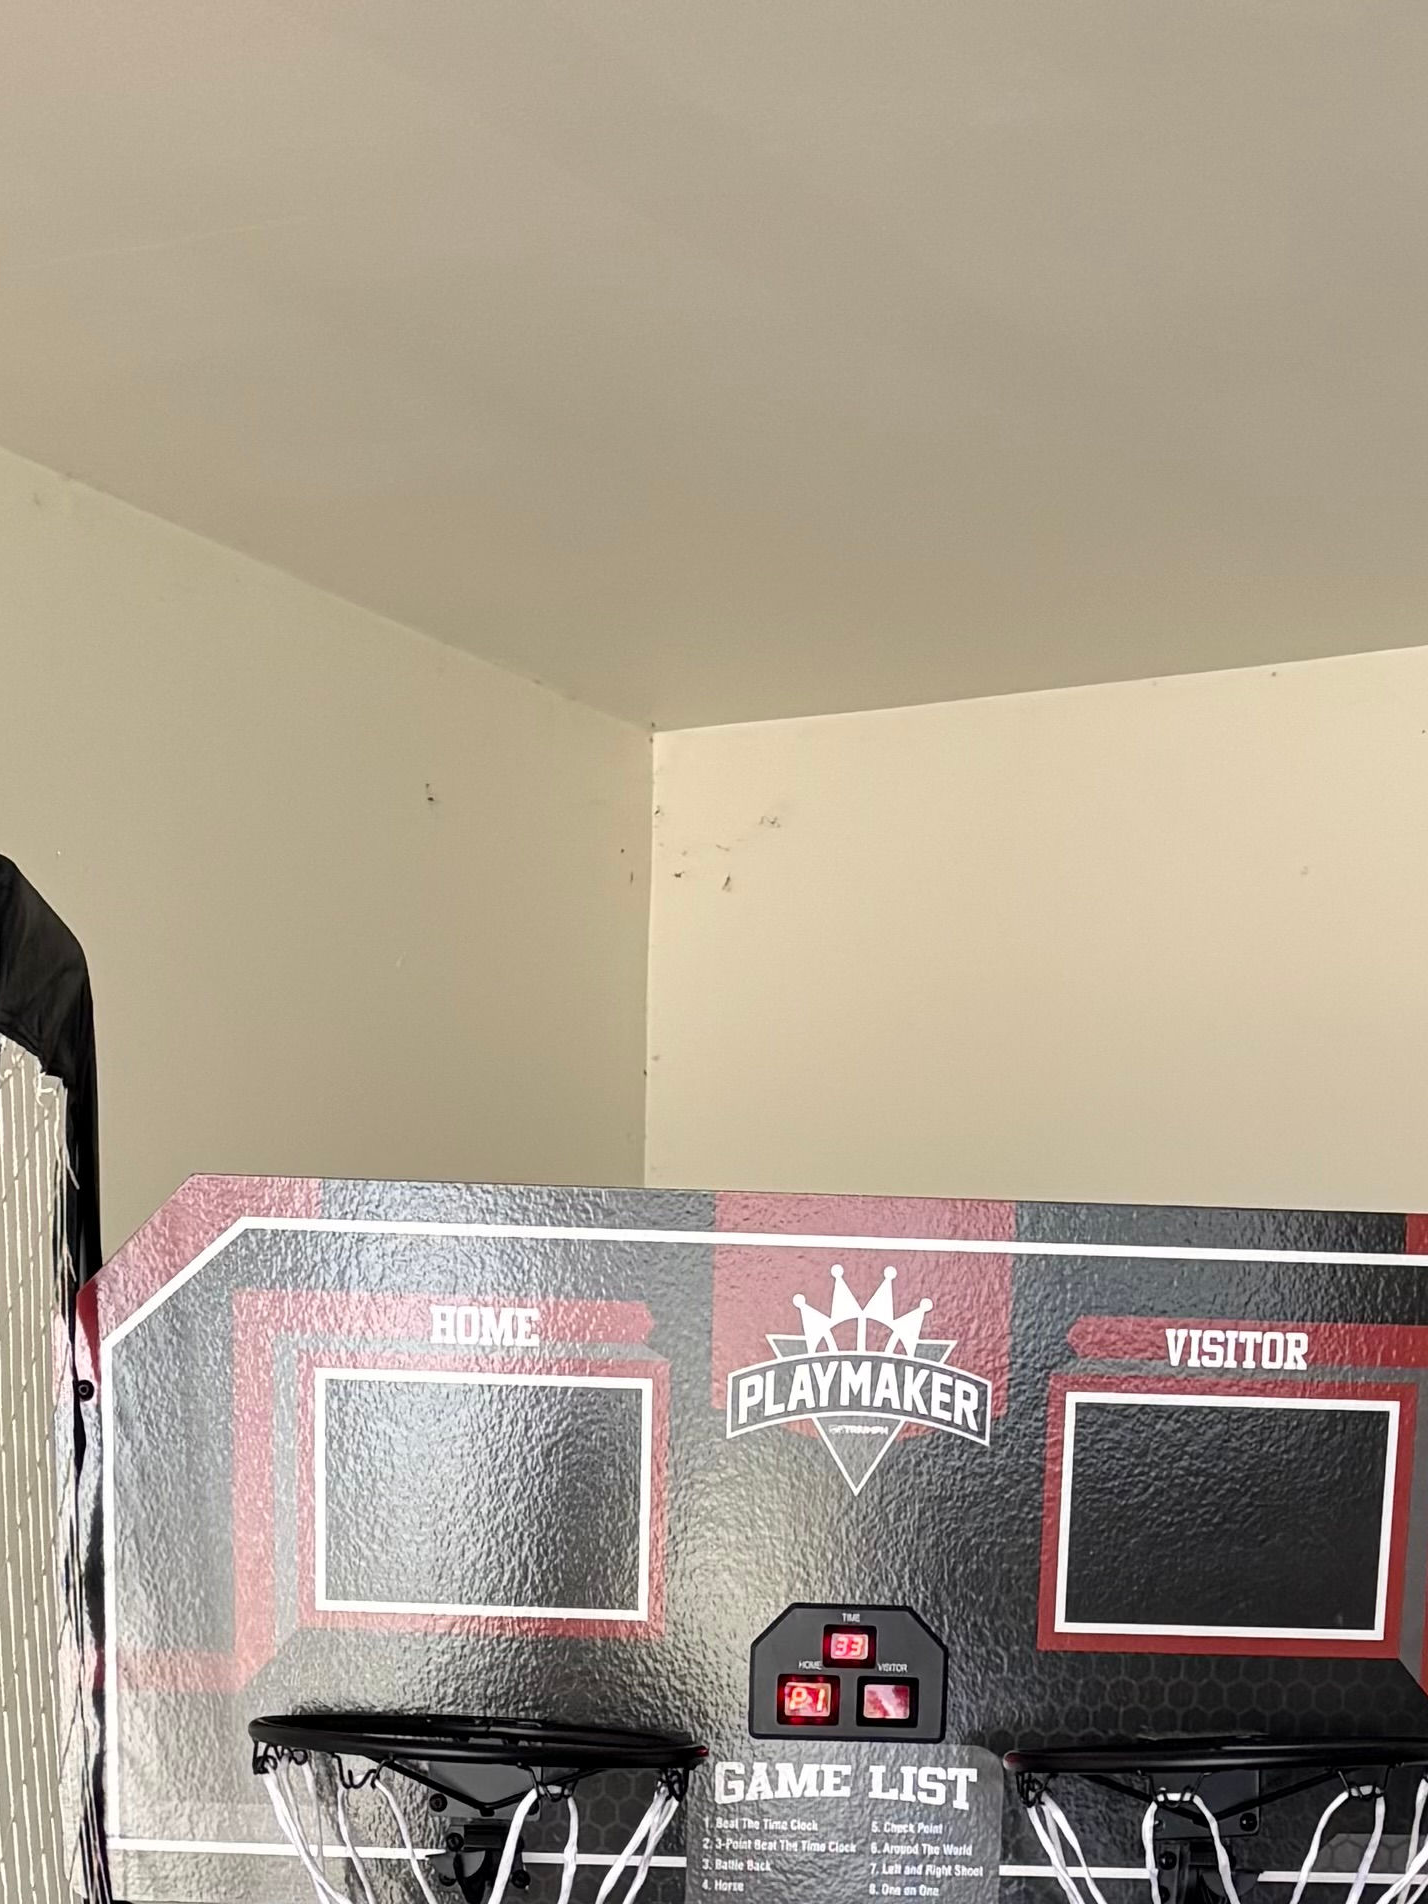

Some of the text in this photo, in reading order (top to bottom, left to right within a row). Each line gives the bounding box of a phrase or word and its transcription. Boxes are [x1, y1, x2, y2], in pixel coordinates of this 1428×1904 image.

[429, 1304, 540, 1348] HOME
[1164, 1328, 1309, 1371] VISITOR
[737, 1359, 980, 1432] PLAYMAKER
[841, 1612, 861, 1624] TIME
[834, 1637, 864, 1657] 33
[798, 1660, 822, 1671] HOME
[877, 1662, 908, 1673] VISITOR
[714, 1760, 978, 1811] GAME LIST
[742, 1817, 760, 1830] The
[763, 1818, 788, 1831] Time
[790, 1818, 819, 1832] Clock
[754, 1839, 777, 1852] Beat
[779, 1839, 798, 1852] The
[801, 1840, 826, 1852] Time
[828, 1841, 857, 1854] Clock
[942, 1843, 973, 1856] World
[746, 1859, 772, 1872] Back
[903, 1863, 923, 1876] and
[925, 1864, 953, 1878] Right
[714, 1879, 745, 1892] Horse
[881, 1883, 902, 1896] One
[919, 1884, 940, 1897] One
